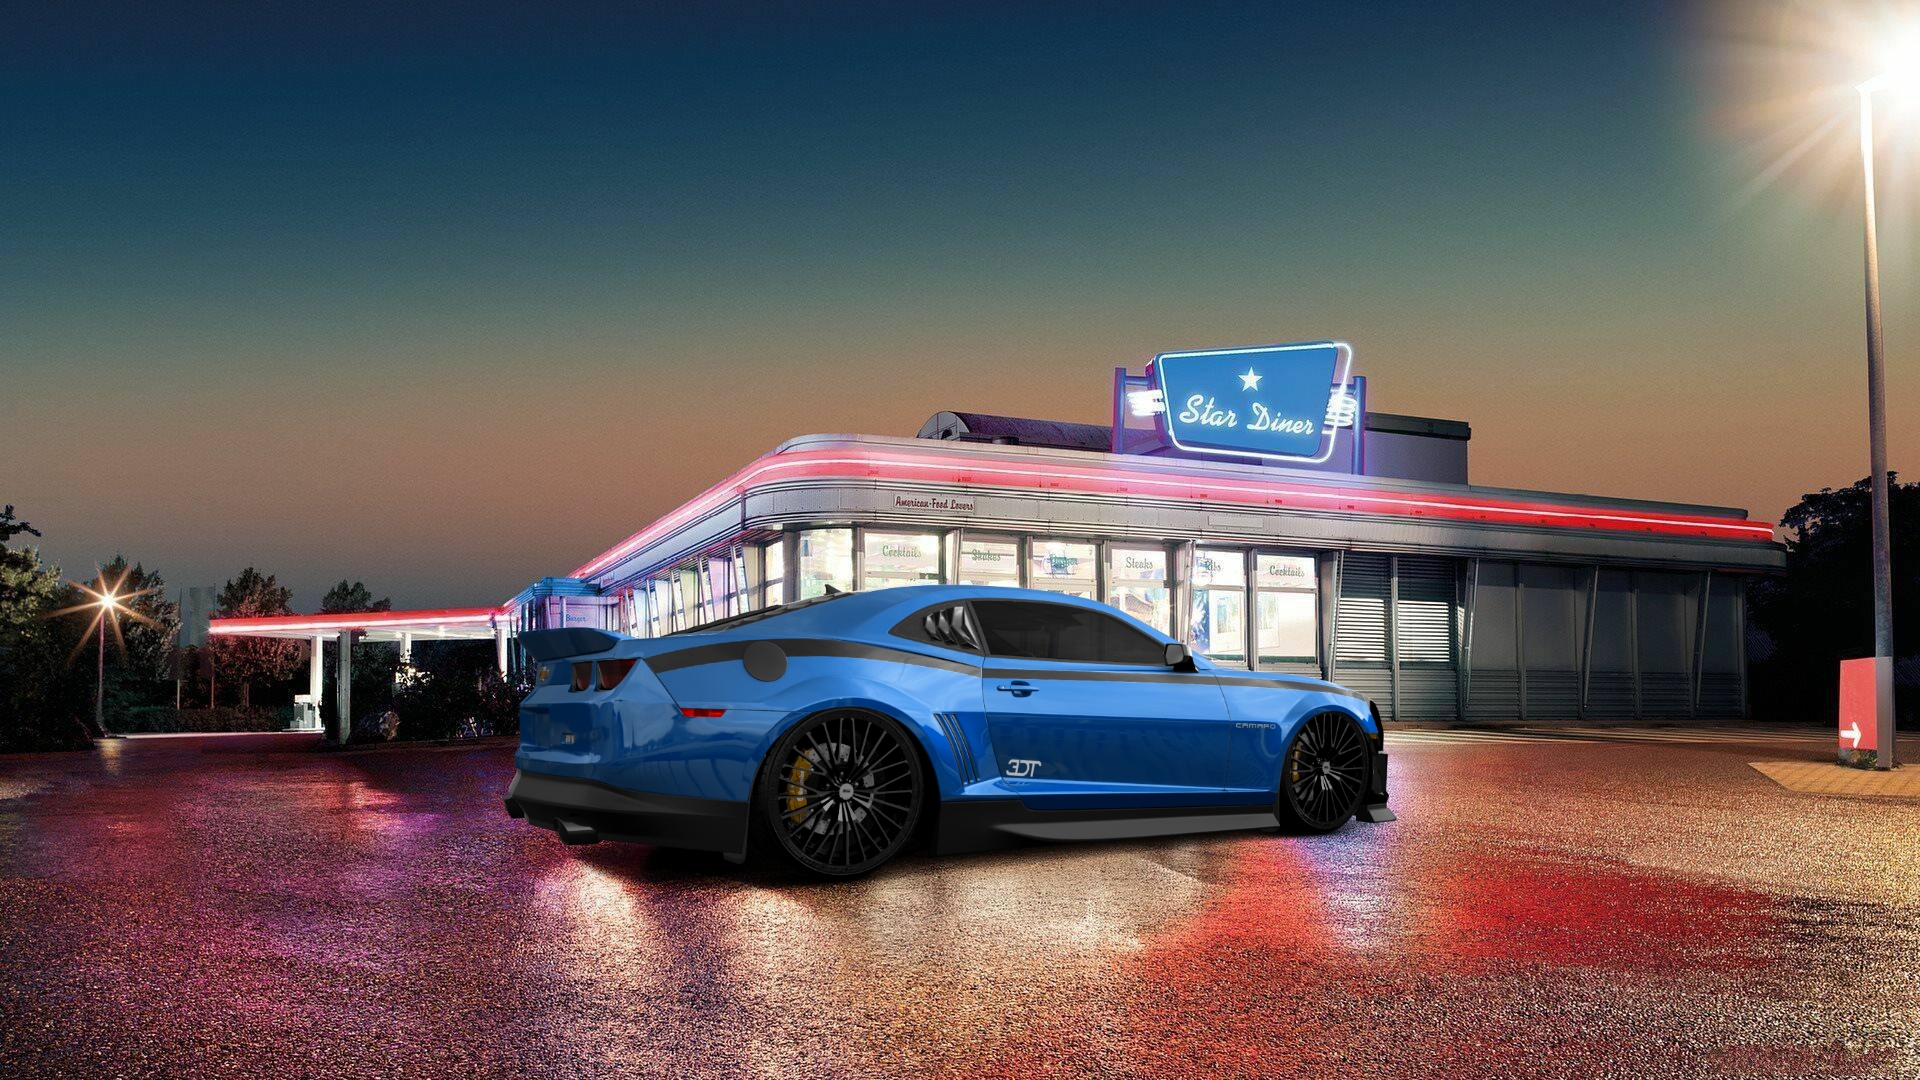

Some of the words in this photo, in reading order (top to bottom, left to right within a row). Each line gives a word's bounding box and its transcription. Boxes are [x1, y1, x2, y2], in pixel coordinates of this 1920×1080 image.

[1179, 394, 1238, 427] Star
[1246, 402, 1314, 435] Diner
[950, 500, 974, 510] Lovers
[882, 545, 921, 558] Cocktails
[1125, 556, 1153, 569] Steaks
[1269, 564, 1305, 578] Cocktails
[1235, 722, 1276, 730] CAMARO
